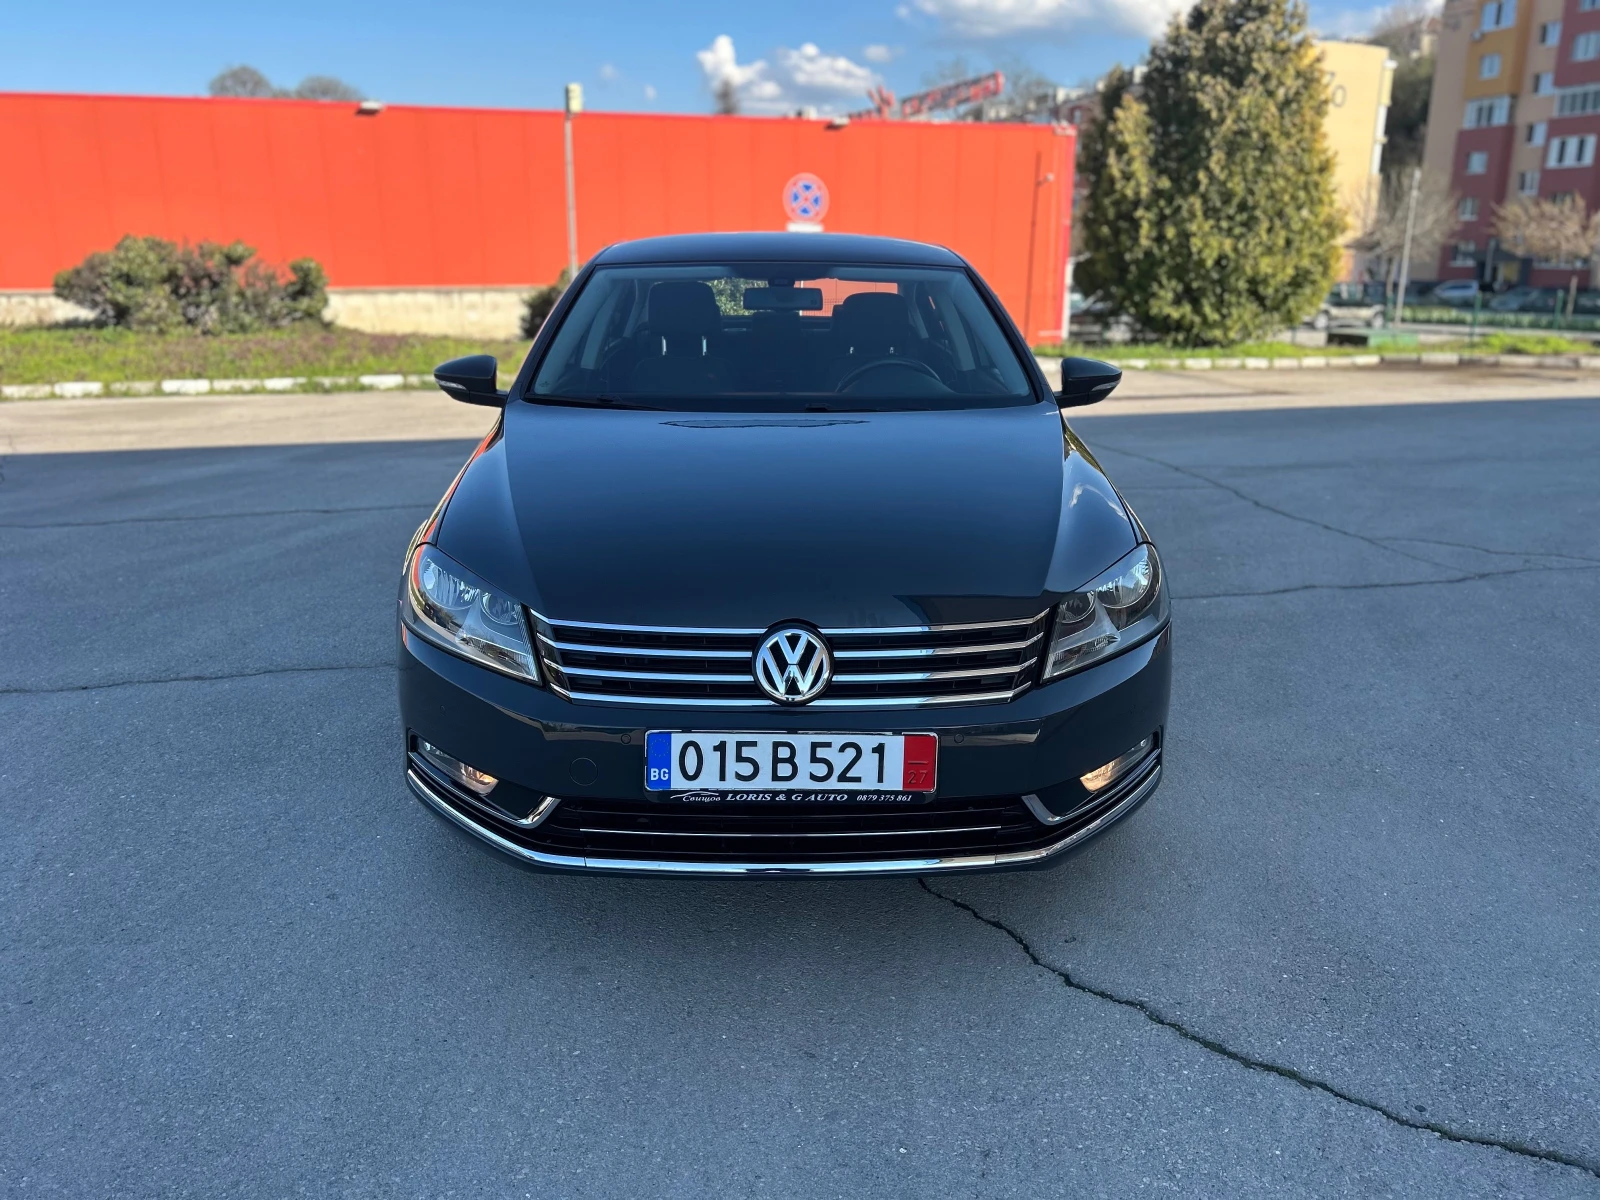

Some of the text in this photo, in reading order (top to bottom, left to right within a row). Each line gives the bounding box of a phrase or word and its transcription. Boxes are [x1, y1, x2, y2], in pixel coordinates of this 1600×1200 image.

[757, 629, 830, 701] VW
[650, 767, 669, 781] BG
[907, 769, 928, 784] 27
[725, 793, 772, 801] LORIS
[791, 793, 803, 801] G
[805, 793, 848, 801] AUTO
